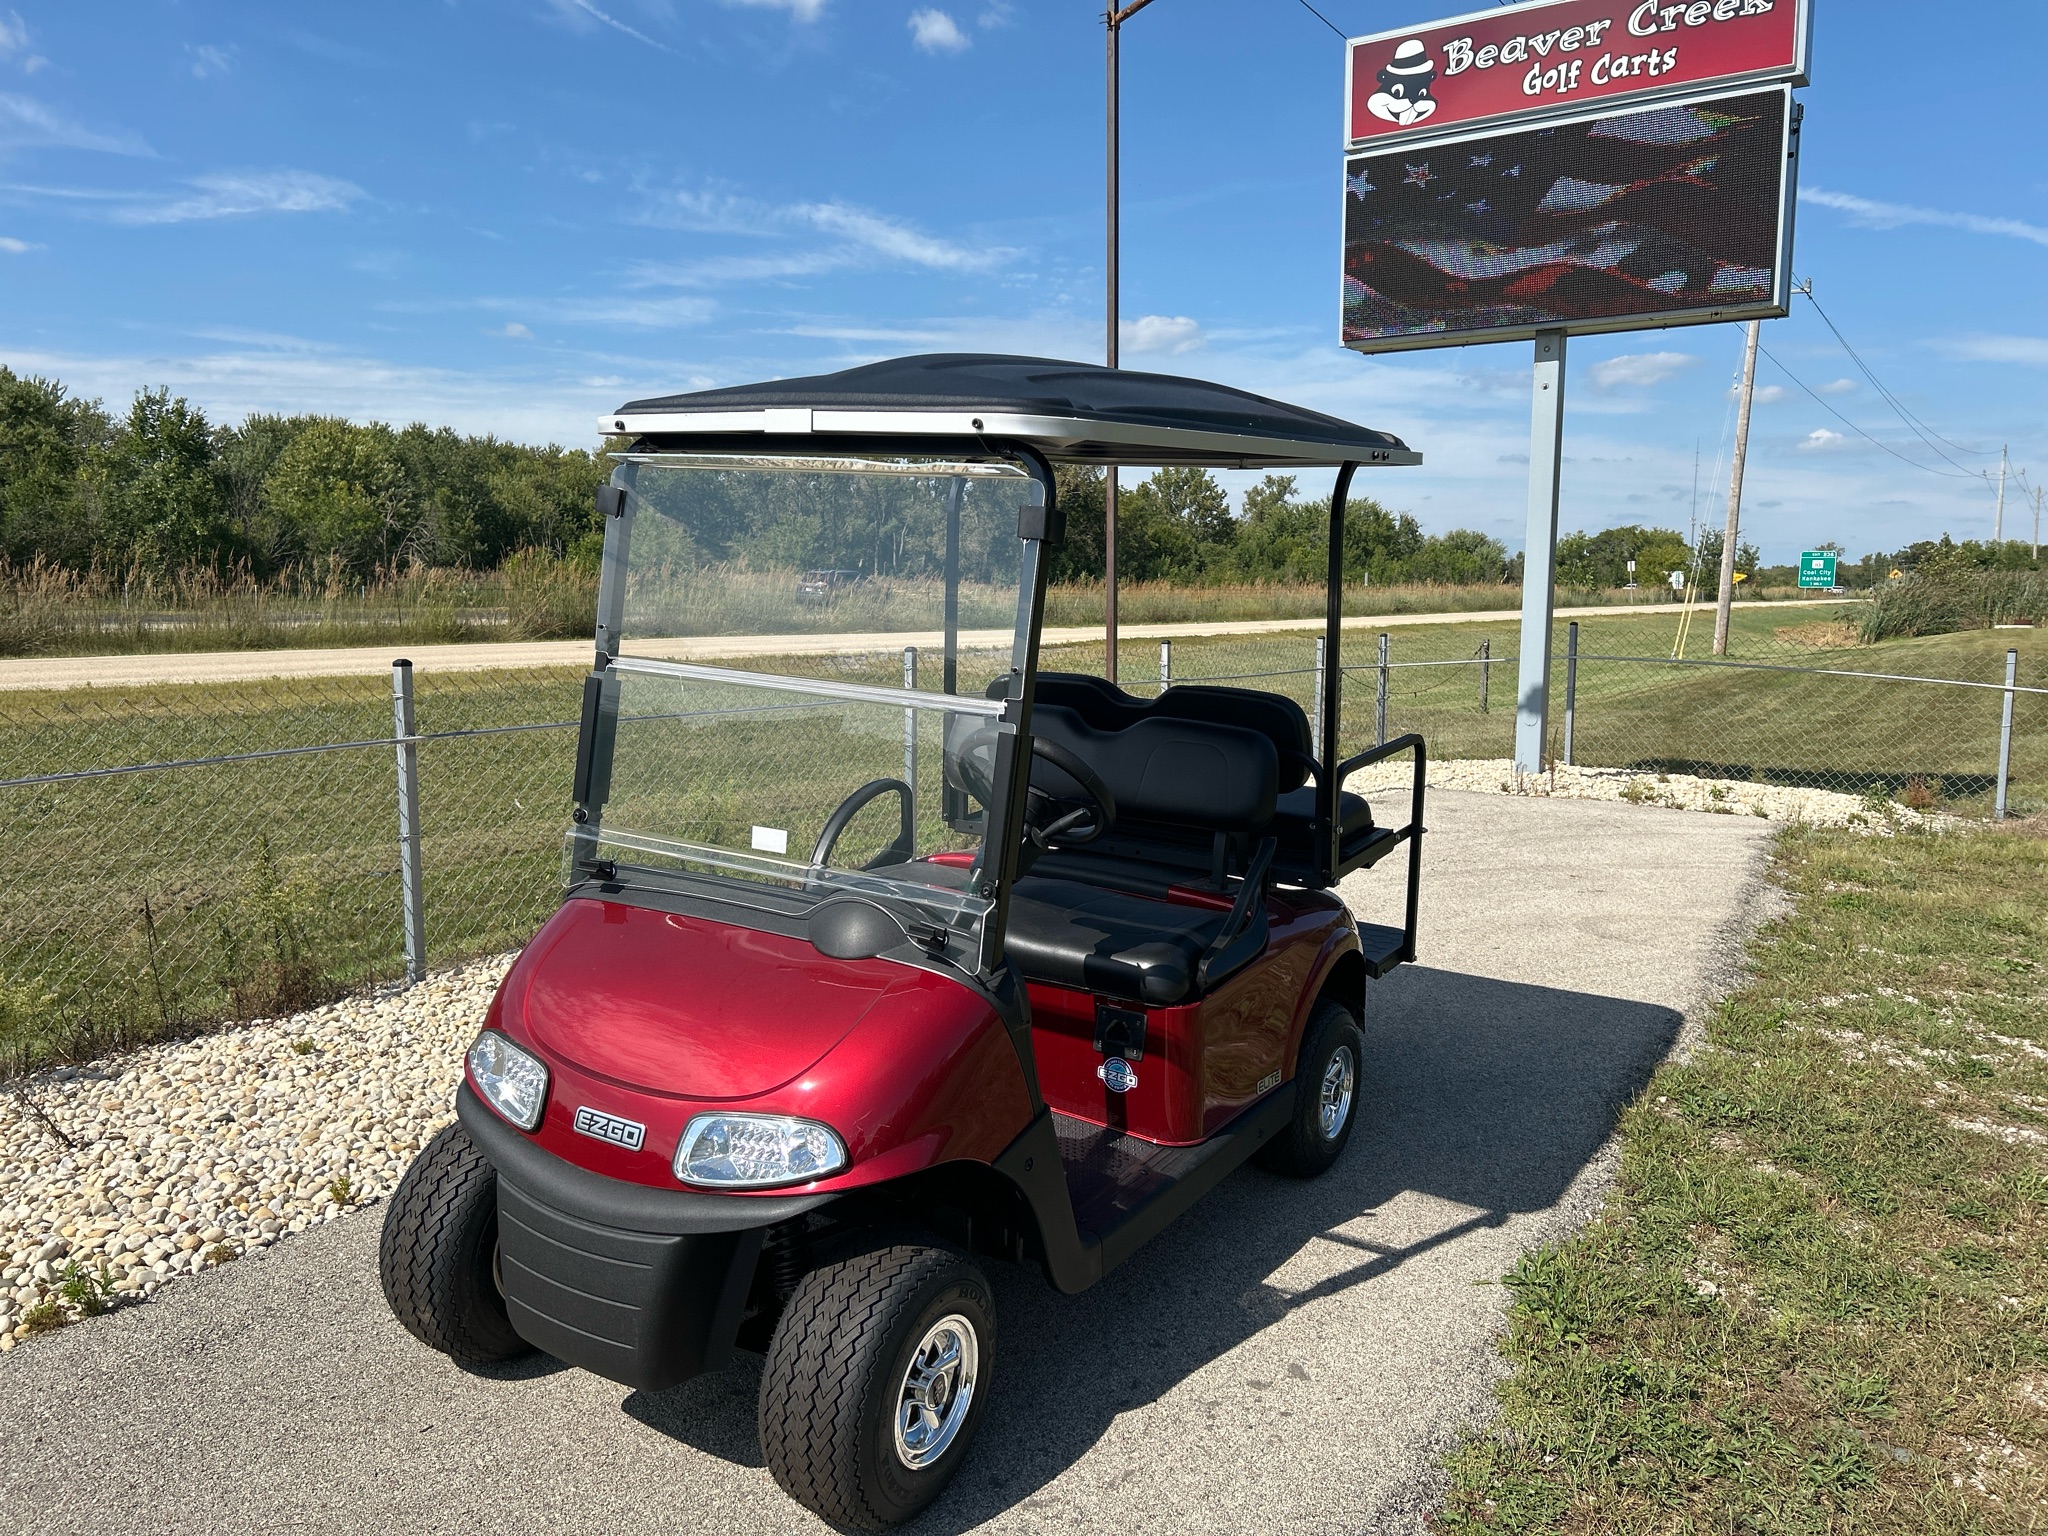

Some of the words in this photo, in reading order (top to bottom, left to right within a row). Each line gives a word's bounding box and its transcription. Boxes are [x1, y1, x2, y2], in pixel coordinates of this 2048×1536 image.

[1443, 19, 1611, 75] Beaver
[1523, 59, 1583, 95] Golf
[1590, 47, 1678, 85] Carts
[1100, 1068, 1135, 1085] EZGO
[1259, 1071, 1280, 1093] ELITE
[576, 1111, 640, 1146] EZGO
